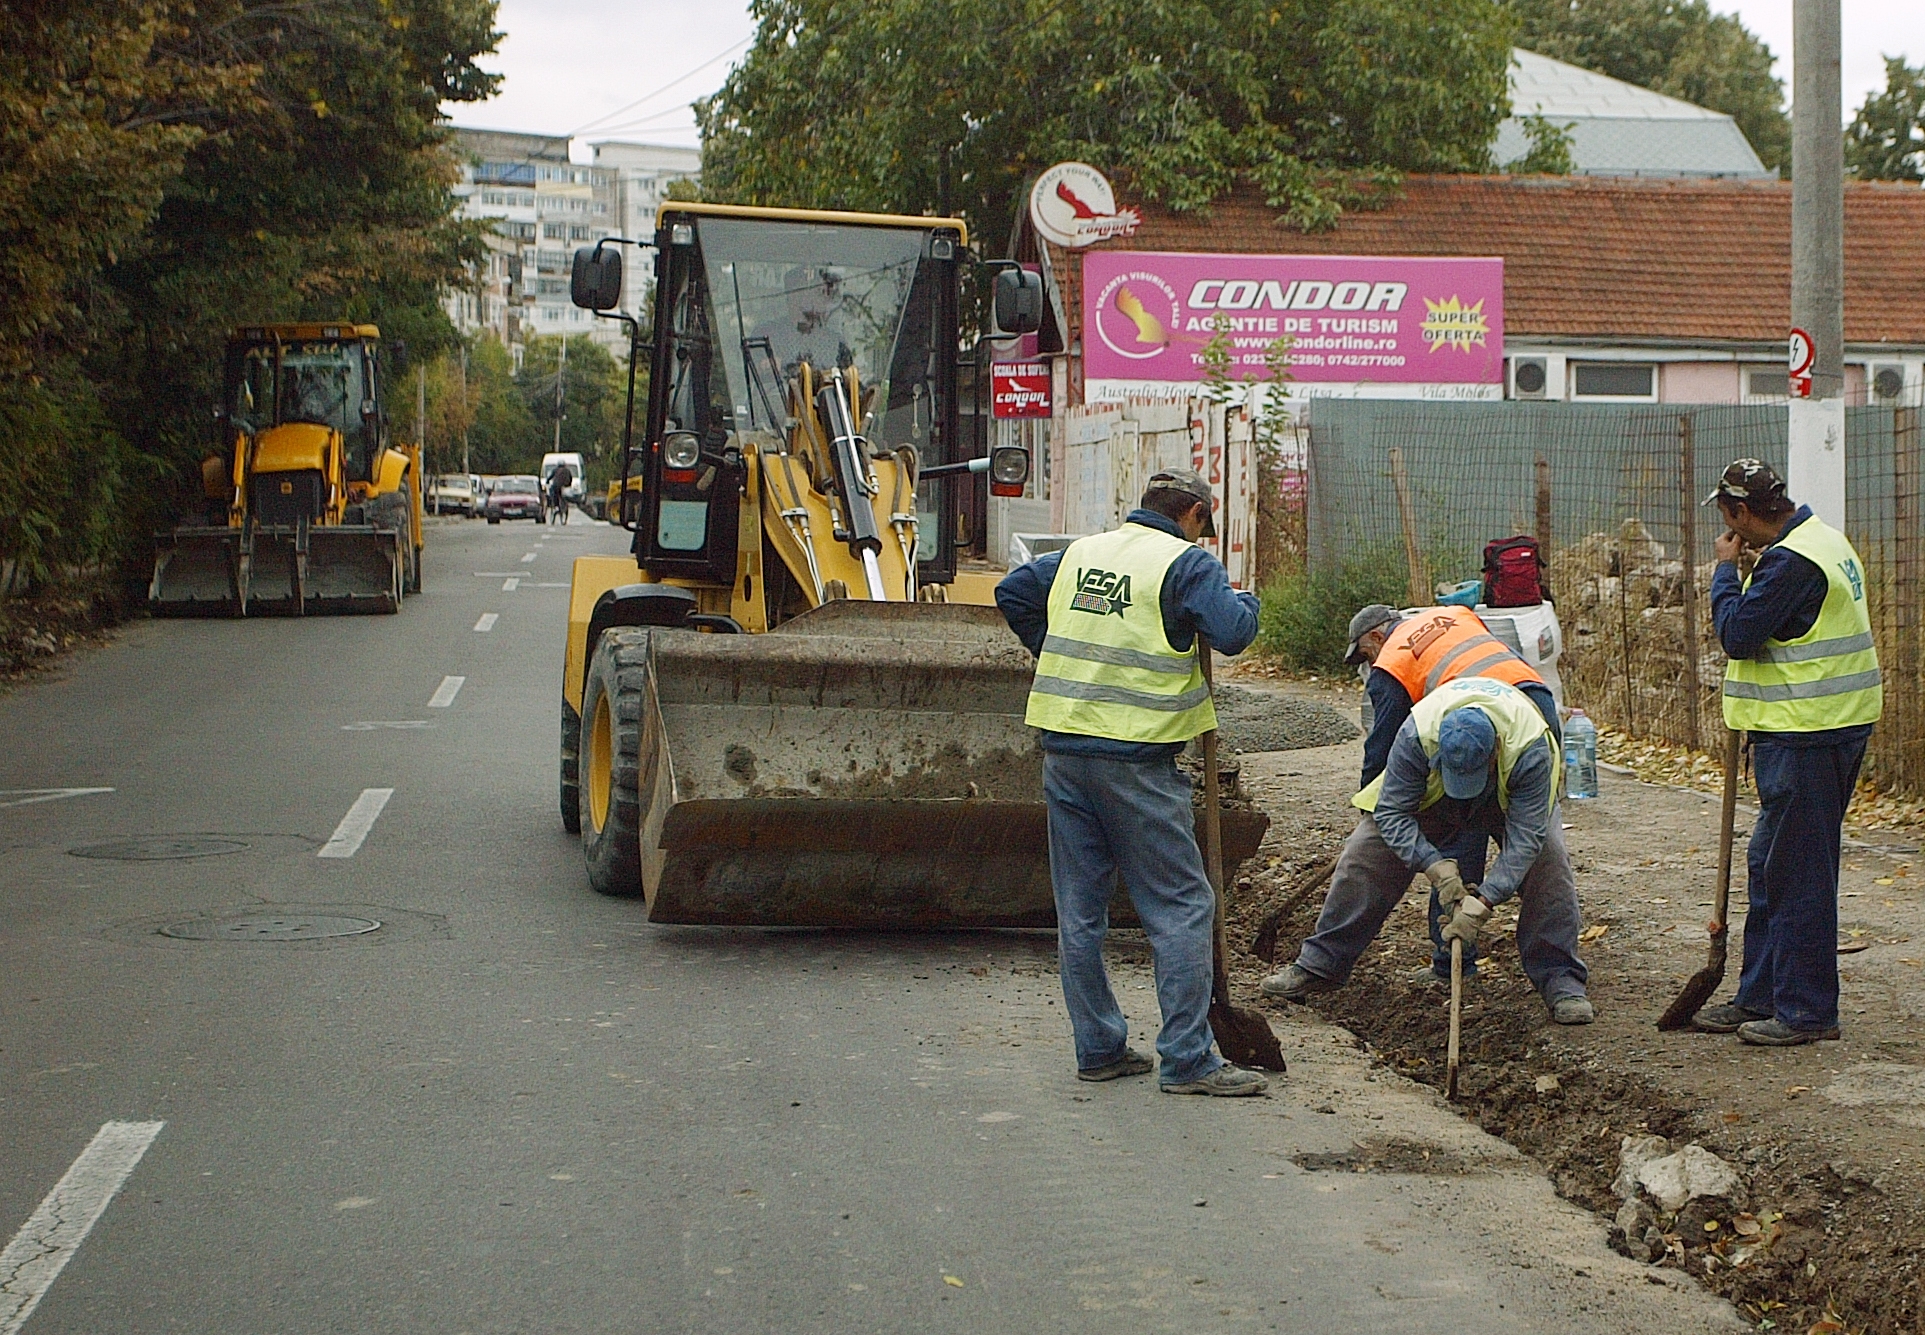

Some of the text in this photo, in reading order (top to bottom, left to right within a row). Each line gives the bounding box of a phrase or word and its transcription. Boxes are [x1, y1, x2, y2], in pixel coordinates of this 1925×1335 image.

[1096, 273, 1129, 309] VACANTA
[1129, 271, 1176, 300] VISURILOR
[1187, 279, 1408, 311] CONDOR
[1284, 317, 1312, 332] DE
[1317, 318, 1399, 333] TURISM
[1423, 311, 1485, 341] SUPER OFERTA
[1327, 354, 1406, 367] 0742/277000
[1076, 567, 1132, 603] VEGA
[1397, 615, 1454, 651] VEGA
